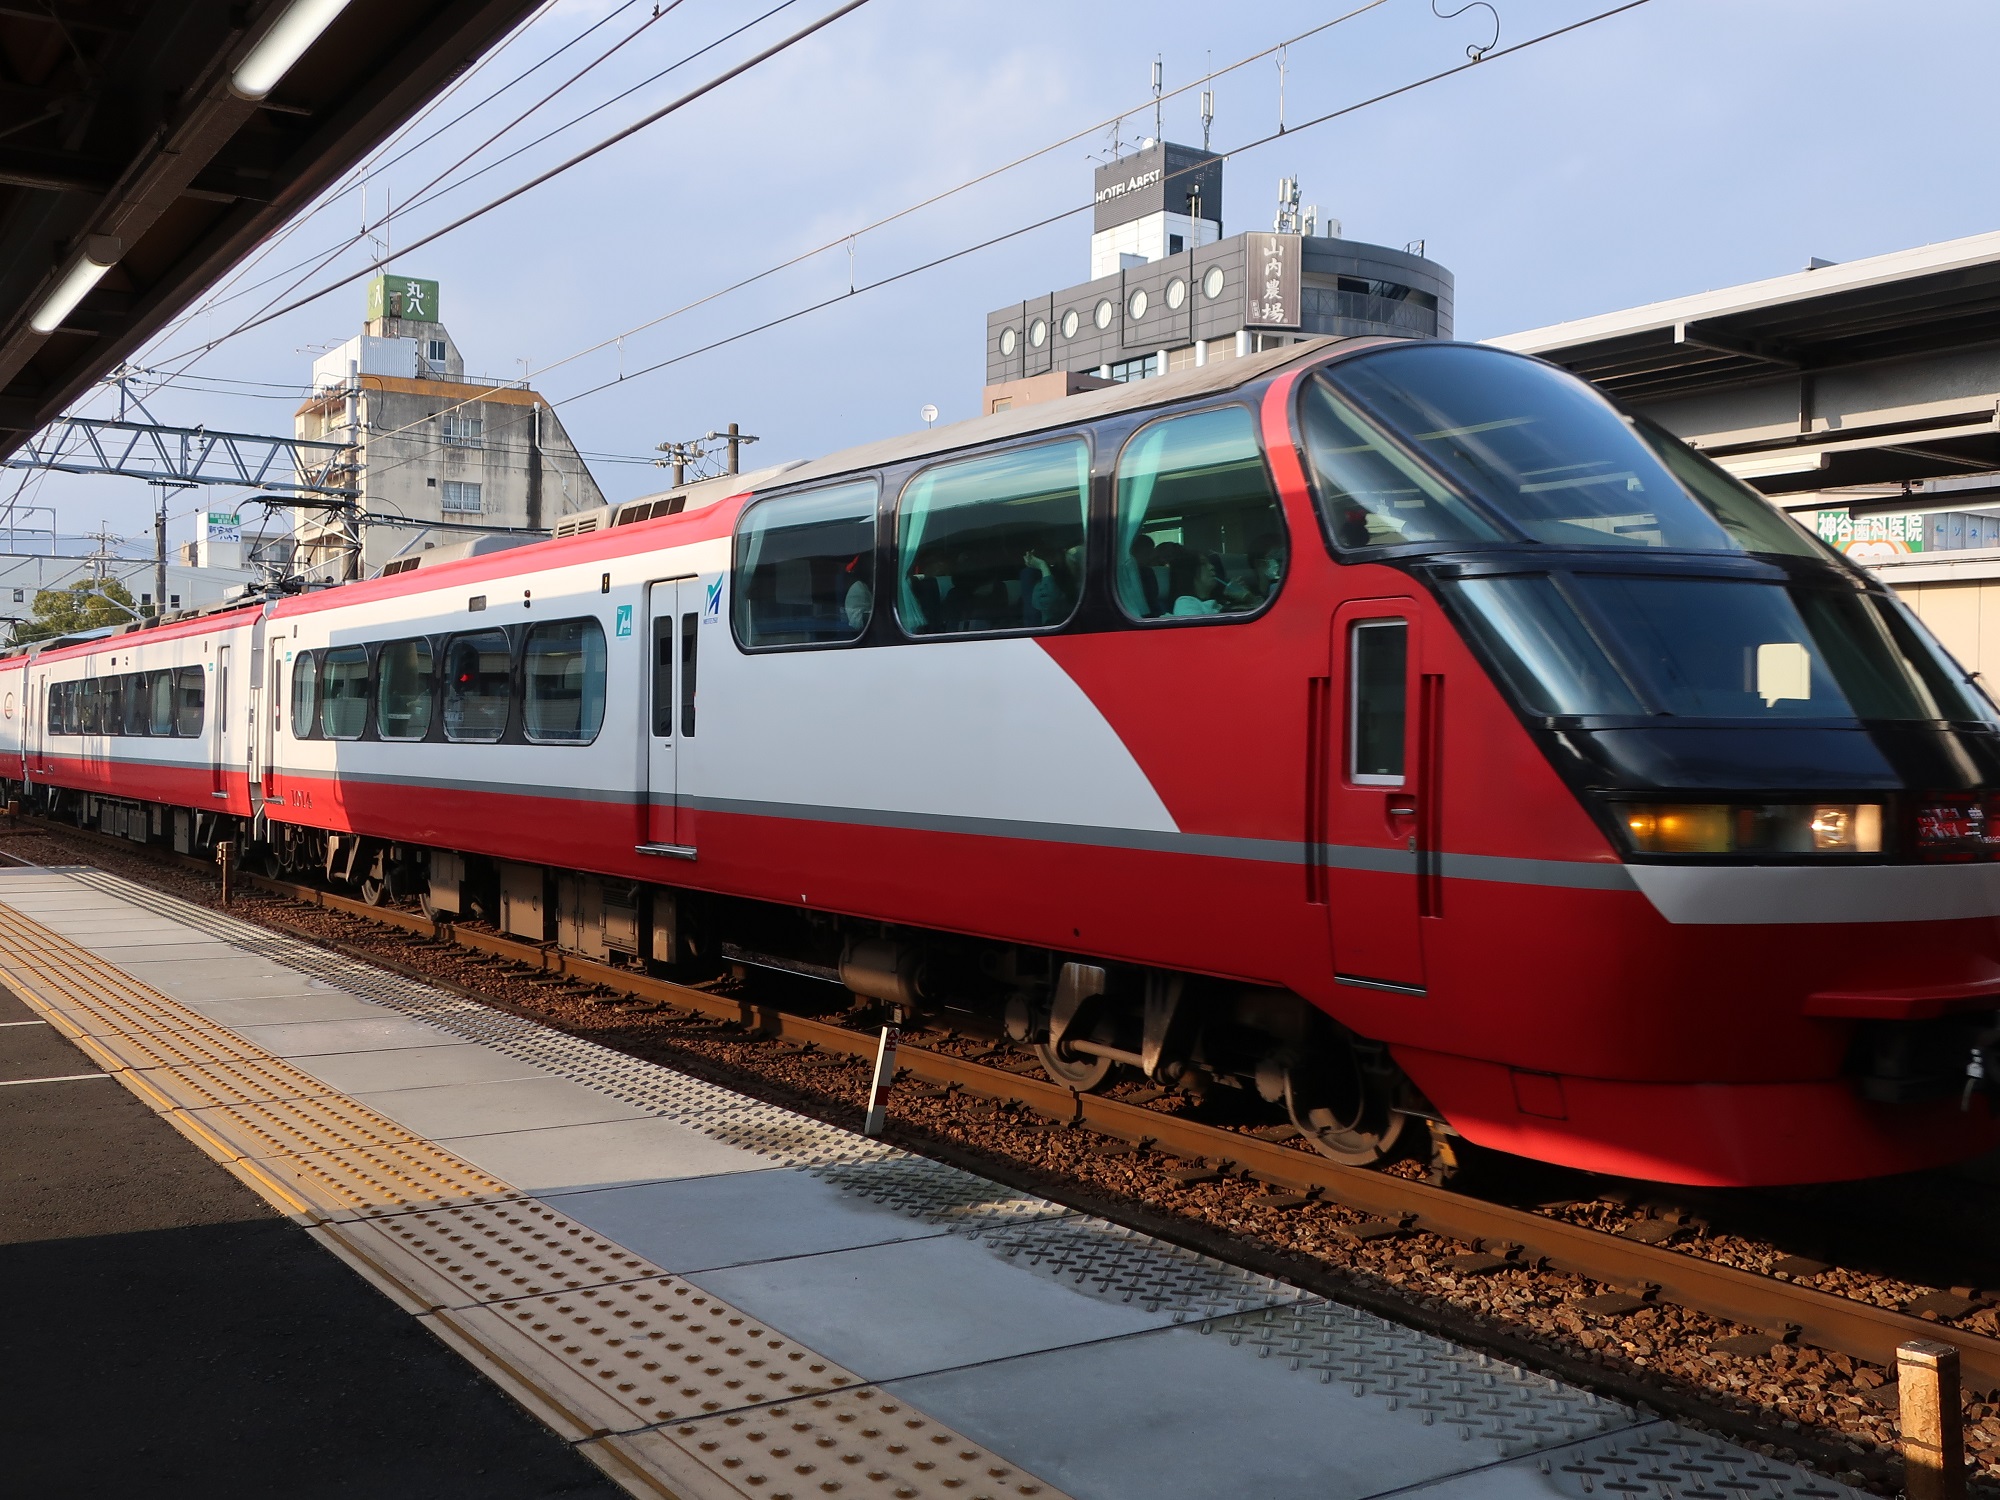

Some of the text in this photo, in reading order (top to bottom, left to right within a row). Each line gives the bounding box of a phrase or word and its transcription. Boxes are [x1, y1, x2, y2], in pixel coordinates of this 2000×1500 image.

[1096, 182, 1126, 206] HOTEL
[1262, 237, 1285, 323] 山内農場
[407, 281, 424, 316] 丸八
[1818, 513, 1923, 542] 神谷歯科医院
